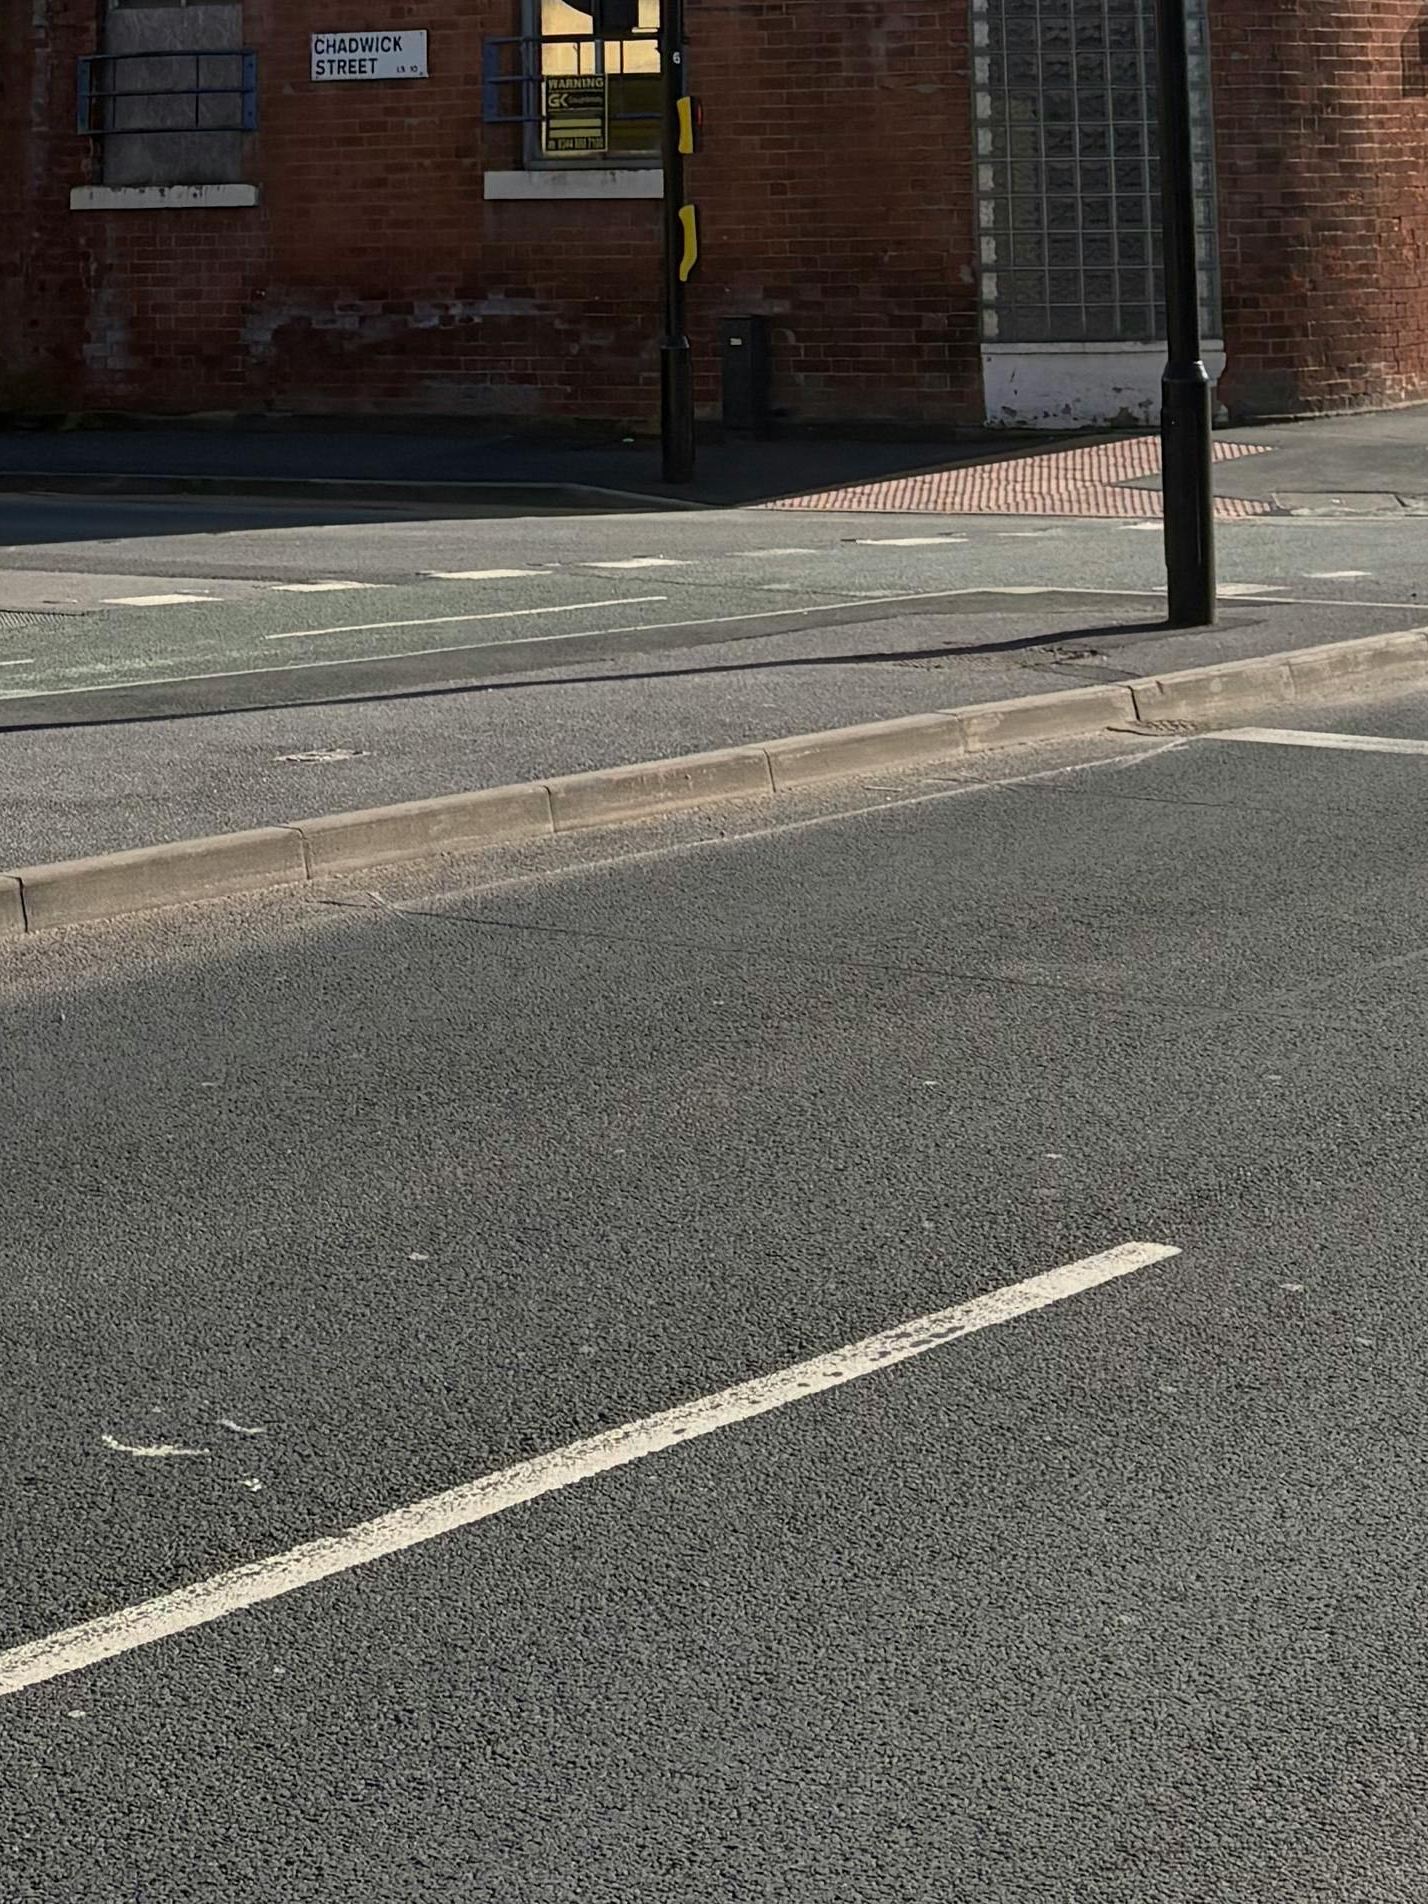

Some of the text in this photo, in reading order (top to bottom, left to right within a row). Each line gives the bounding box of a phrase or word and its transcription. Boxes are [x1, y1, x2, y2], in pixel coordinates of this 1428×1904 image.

[314, 36, 403, 54] CHADWICK
[672, 52, 681, 64] 6
[315, 58, 378, 75] STREET
[548, 78, 604, 89] WARNING
